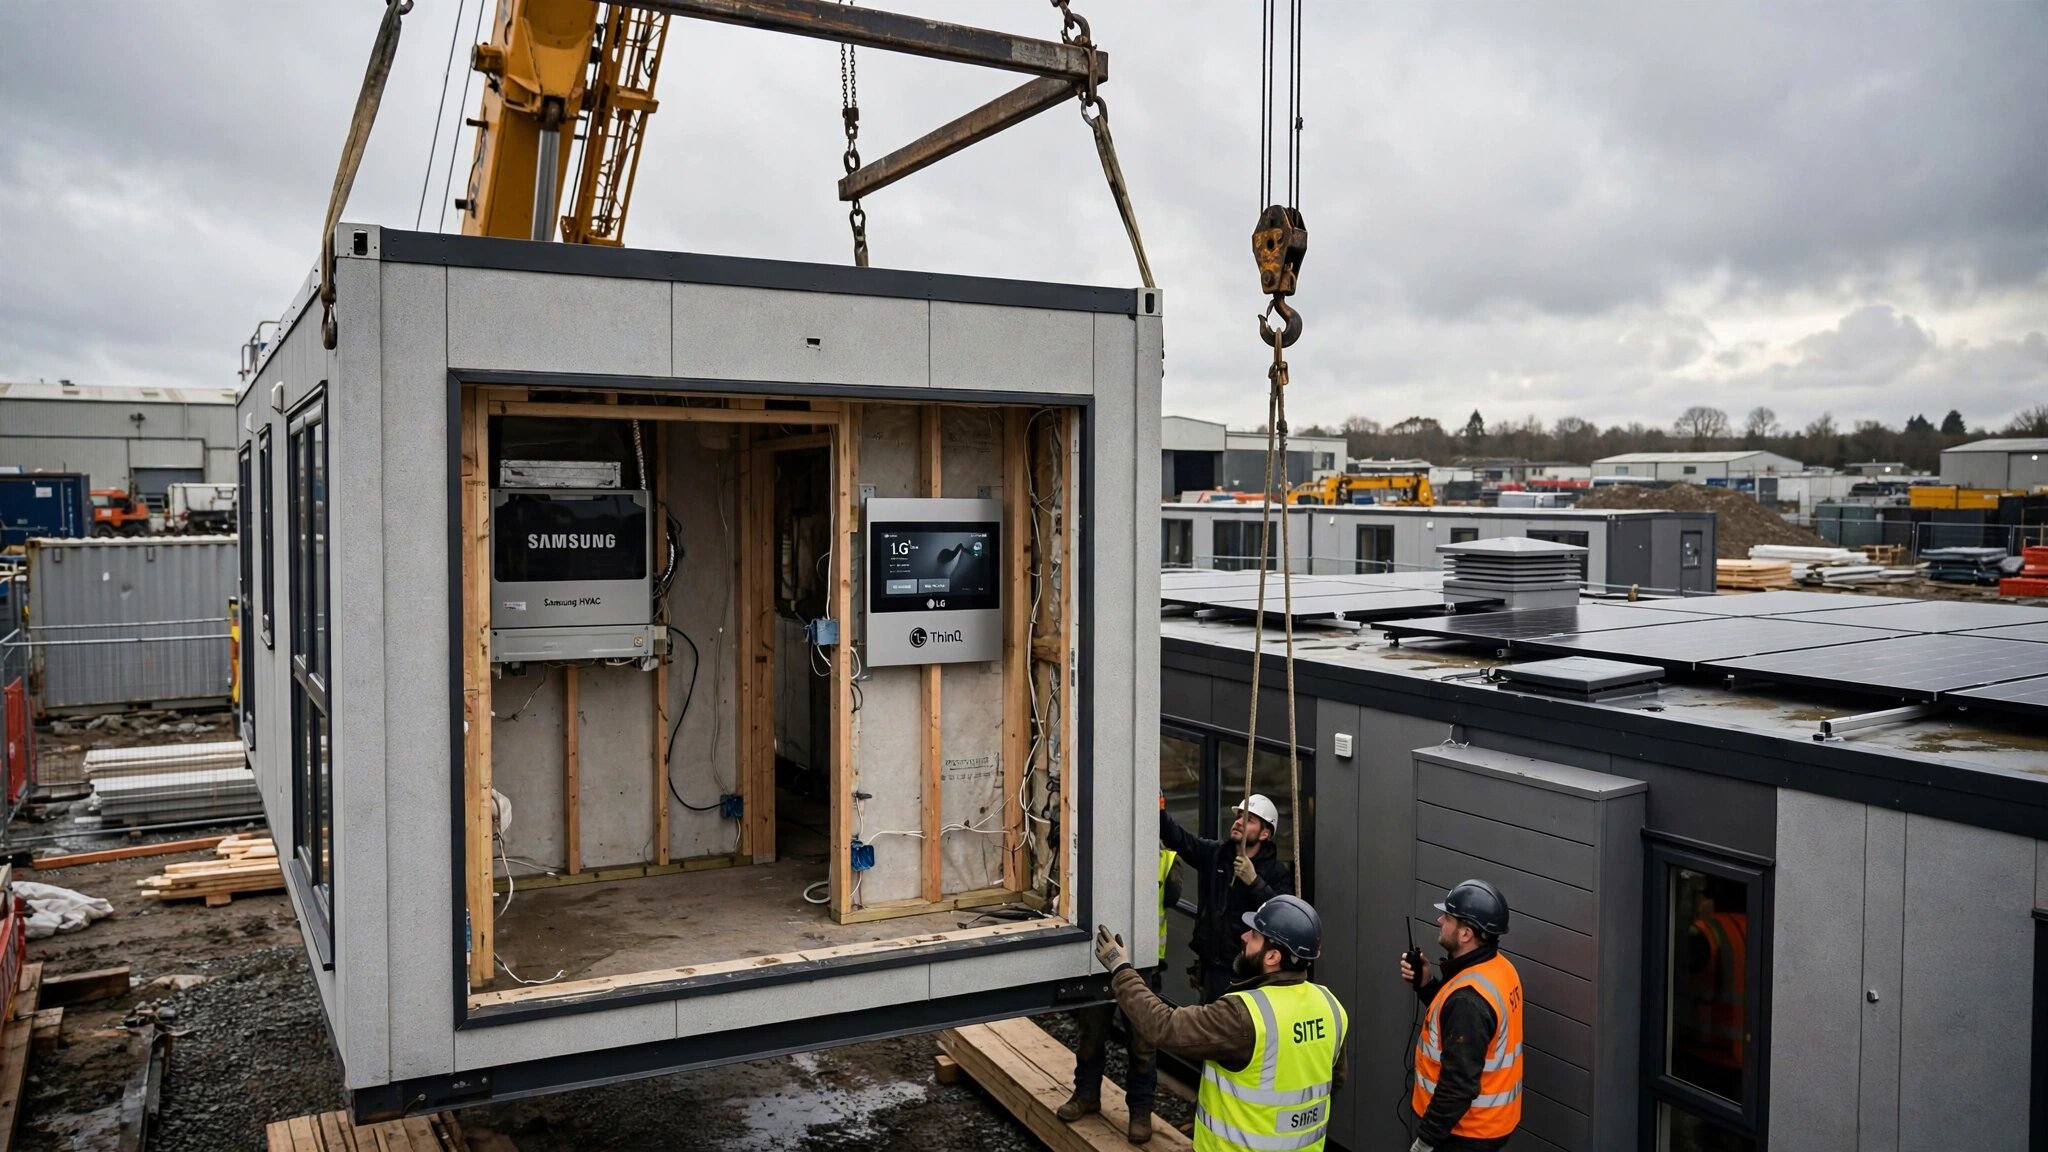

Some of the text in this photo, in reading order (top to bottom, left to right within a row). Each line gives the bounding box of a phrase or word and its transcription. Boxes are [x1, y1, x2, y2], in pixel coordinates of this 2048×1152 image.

[528, 533, 616, 549] SAMSUNG
[544, 597, 601, 608] Samsung HVAC
[935, 599, 946, 608] LG
[930, 630, 963, 644] ThinQ
[1293, 1018, 1326, 1044] SITE
